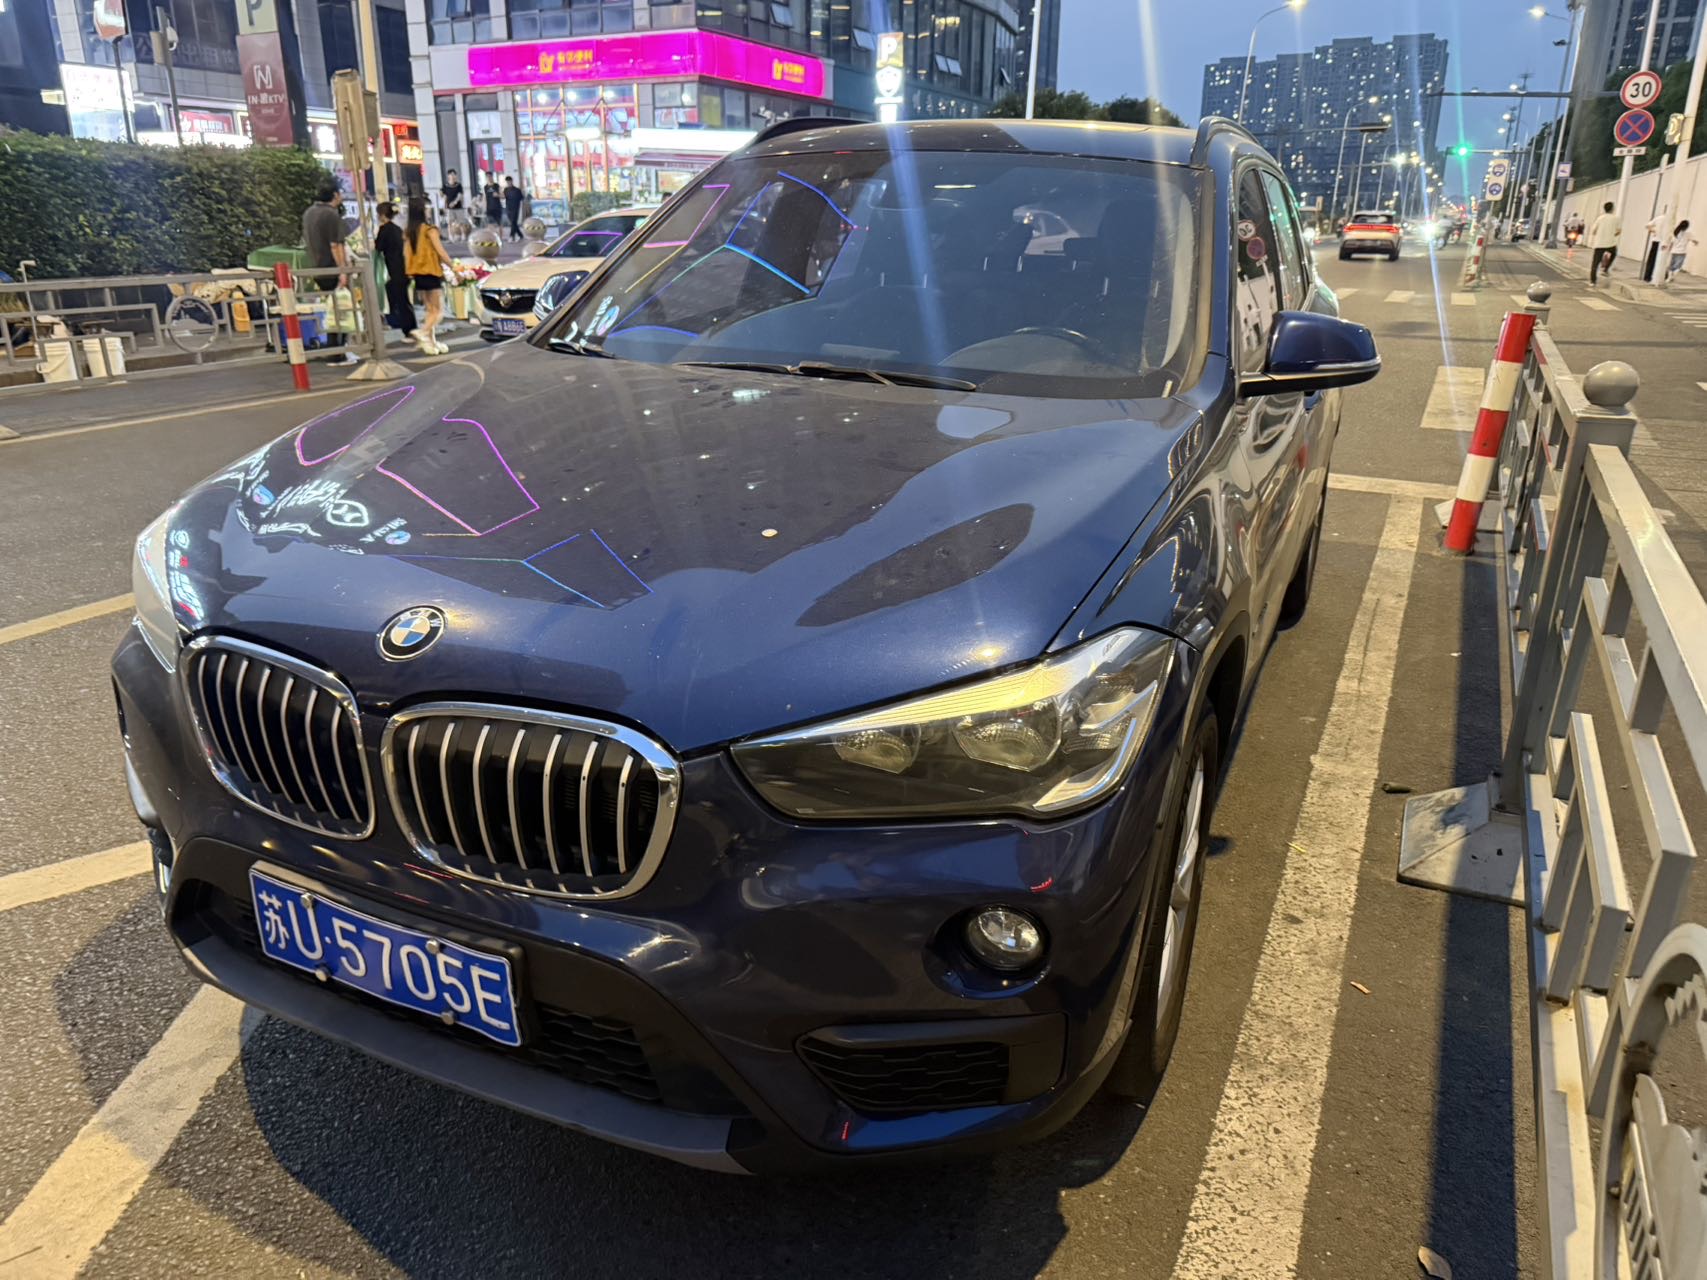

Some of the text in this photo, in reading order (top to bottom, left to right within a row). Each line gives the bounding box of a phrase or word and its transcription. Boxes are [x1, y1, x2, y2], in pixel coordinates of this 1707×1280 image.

[880, 37, 897, 63] P
[1630, 82, 1652, 98] 30
[257, 890, 511, 1031] 苏U·5705E
